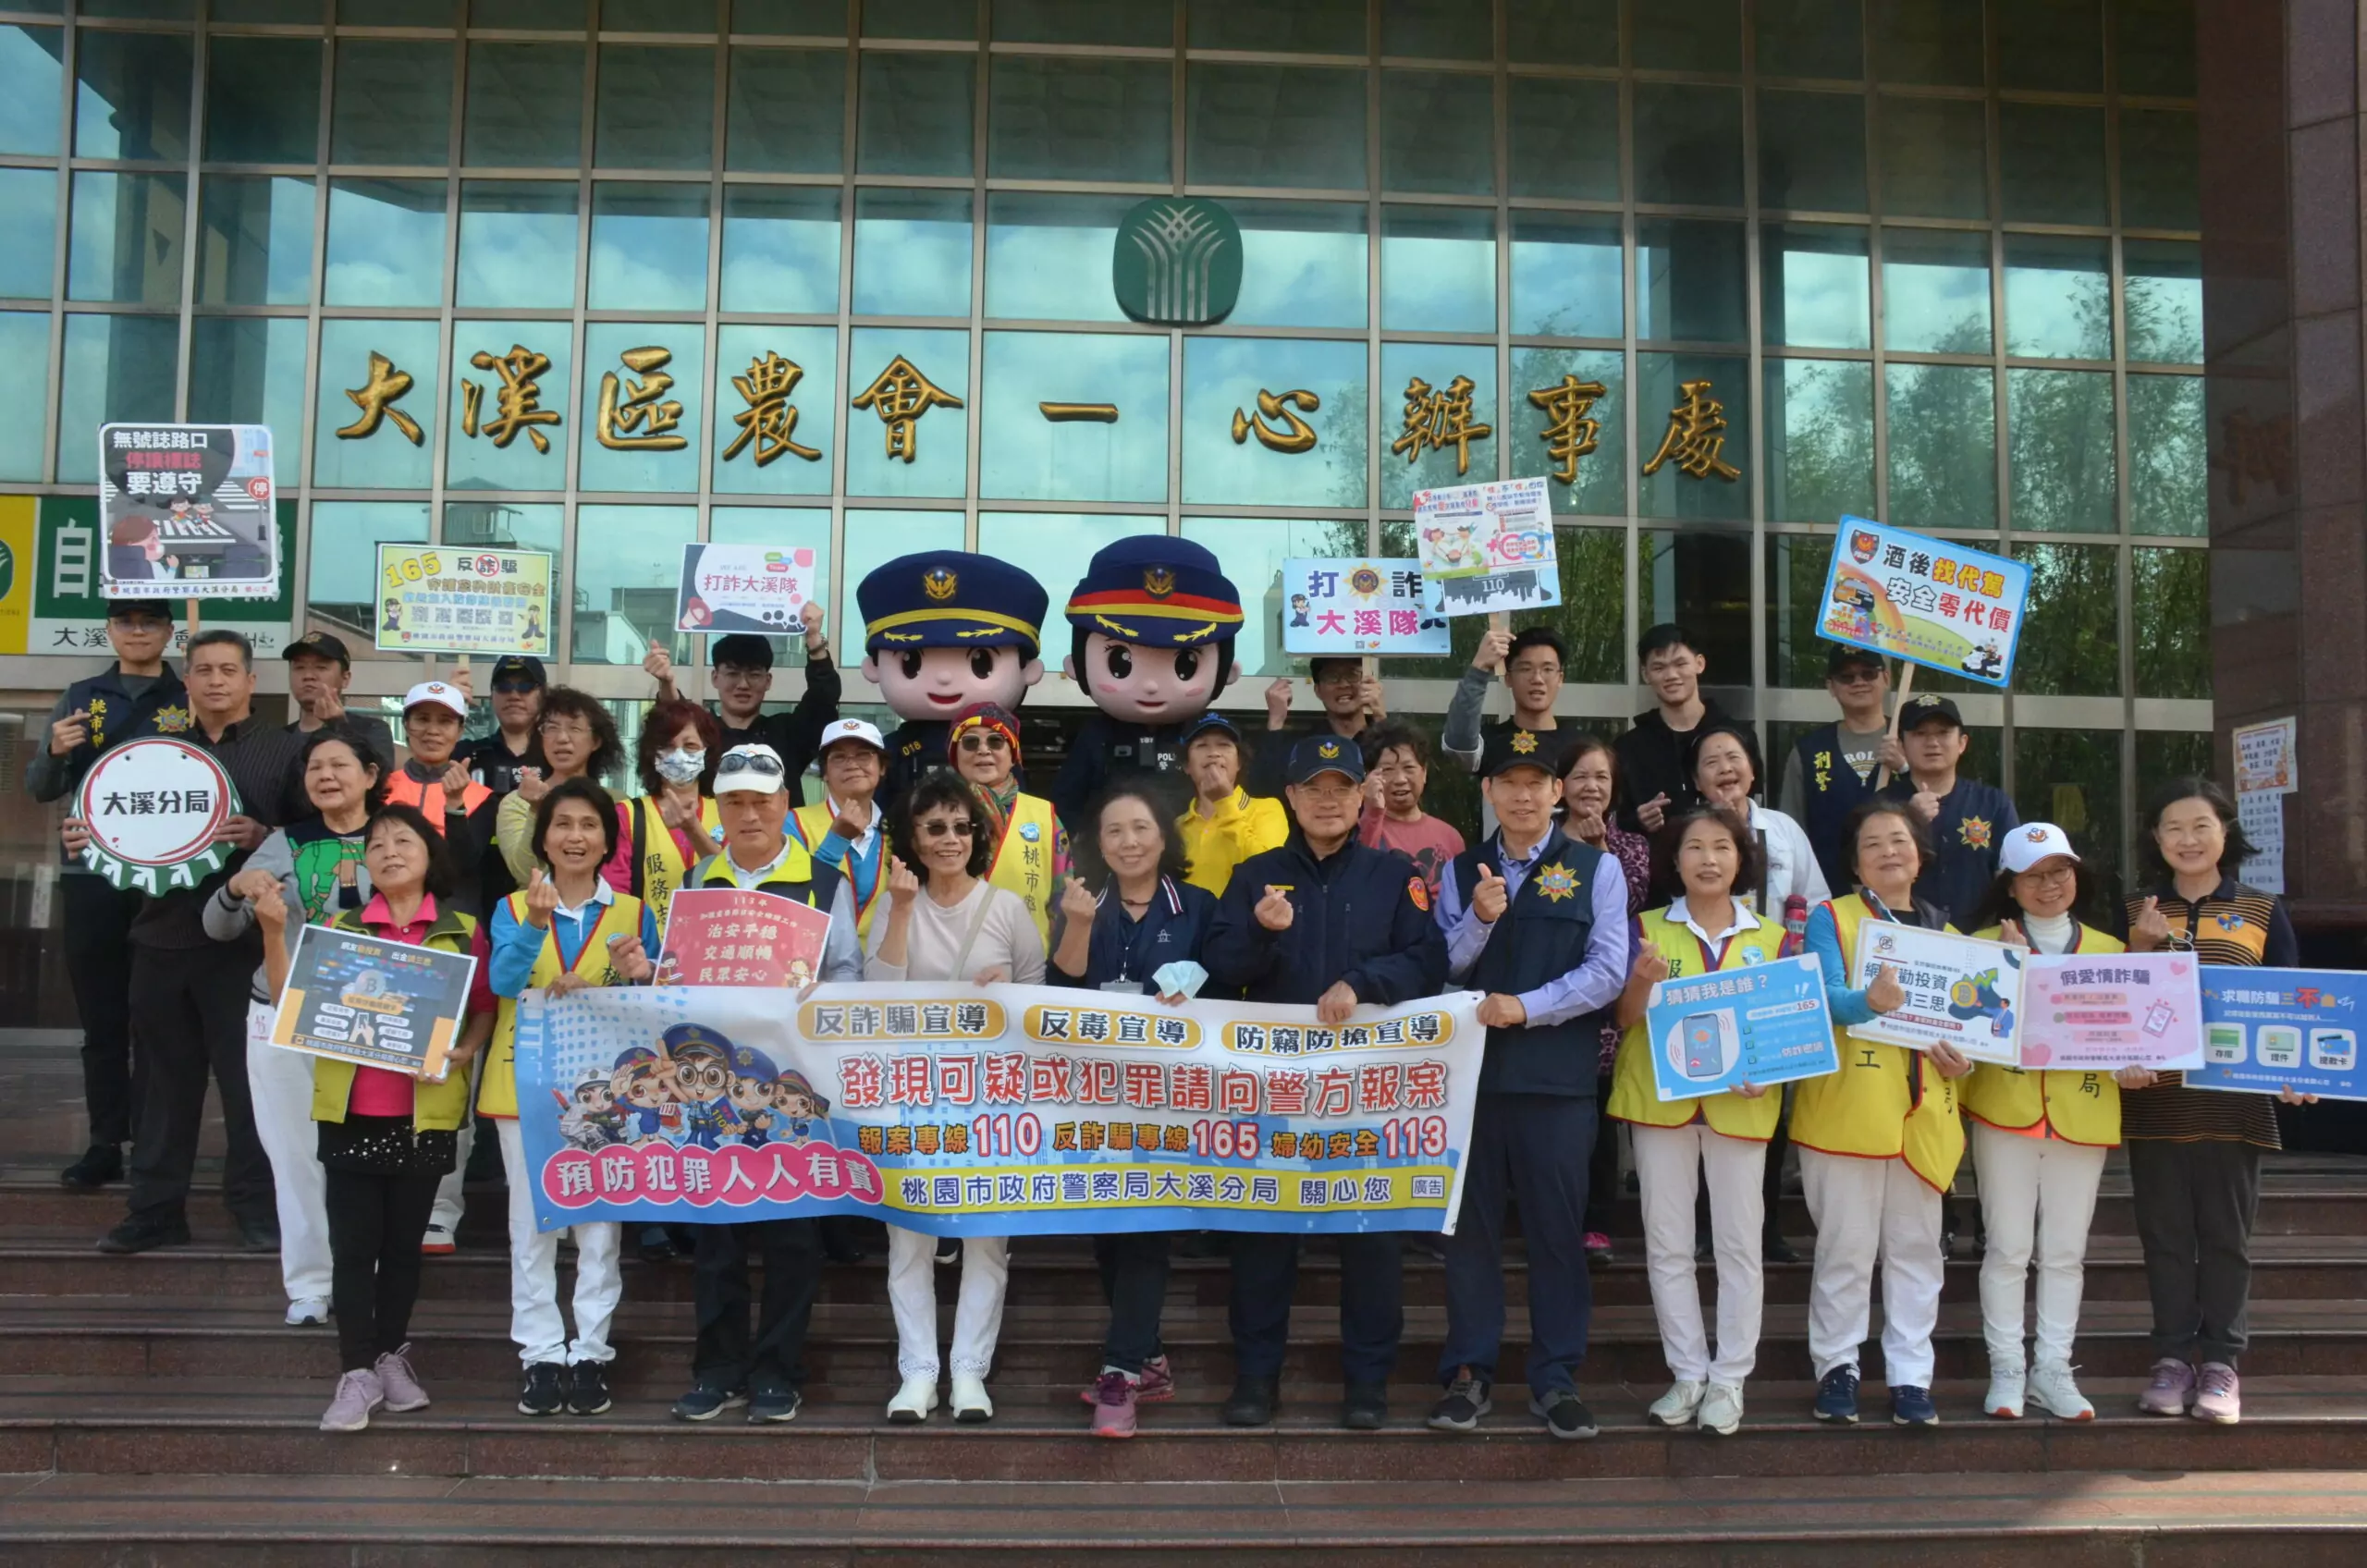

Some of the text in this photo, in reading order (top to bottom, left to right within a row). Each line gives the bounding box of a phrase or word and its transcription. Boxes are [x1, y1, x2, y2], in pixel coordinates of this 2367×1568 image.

[113, 431, 208, 449] 無號誌路口
[126, 472, 202, 495] 要遵守
[386, 551, 441, 588] 165
[1883, 544, 2005, 598] 酒後找代駕
[705, 574, 798, 594] 打詐大溪隊
[1308, 570, 1422, 598] 打 詐
[1481, 579, 1505, 592] 110
[1887, 577, 2012, 633] 安全零代價
[1317, 610, 1419, 635] 大溪隊
[1813, 751, 1832, 791] 刑警
[103, 790, 210, 815] 大溪分局
[707, 923, 778, 940] 治安平穩
[703, 945, 773, 962] 交通順暢
[699, 967, 767, 984] 民眾安心
[1865, 962, 1947, 993] 網勸投資
[2060, 968, 2151, 986] 假愛情詐騙
[814, 1003, 987, 1036] 反詐騙宣導
[1797, 1000, 1816, 1011] 165
[1038, 1010, 1188, 1045] 反毒宣導
[1236, 1014, 1442, 1056] 防竊防搶宣導
[839, 1051, 1450, 1118] 發現可疑或犯罪請向警方報案
[2079, 1072, 2100, 1099] 局
[858, 1125, 970, 1157] 報案專線
[972, 1111, 1042, 1158] 110
[1193, 1118, 1261, 1160] 165
[1270, 1128, 1381, 1159] 婦幼安全
[1382, 1115, 1449, 1160] 113
[556, 1149, 876, 1198] 預防犯罪人人有責
[901, 1170, 1443, 1207] 桃園市政府警察局大溪分局 關心您 廣告
